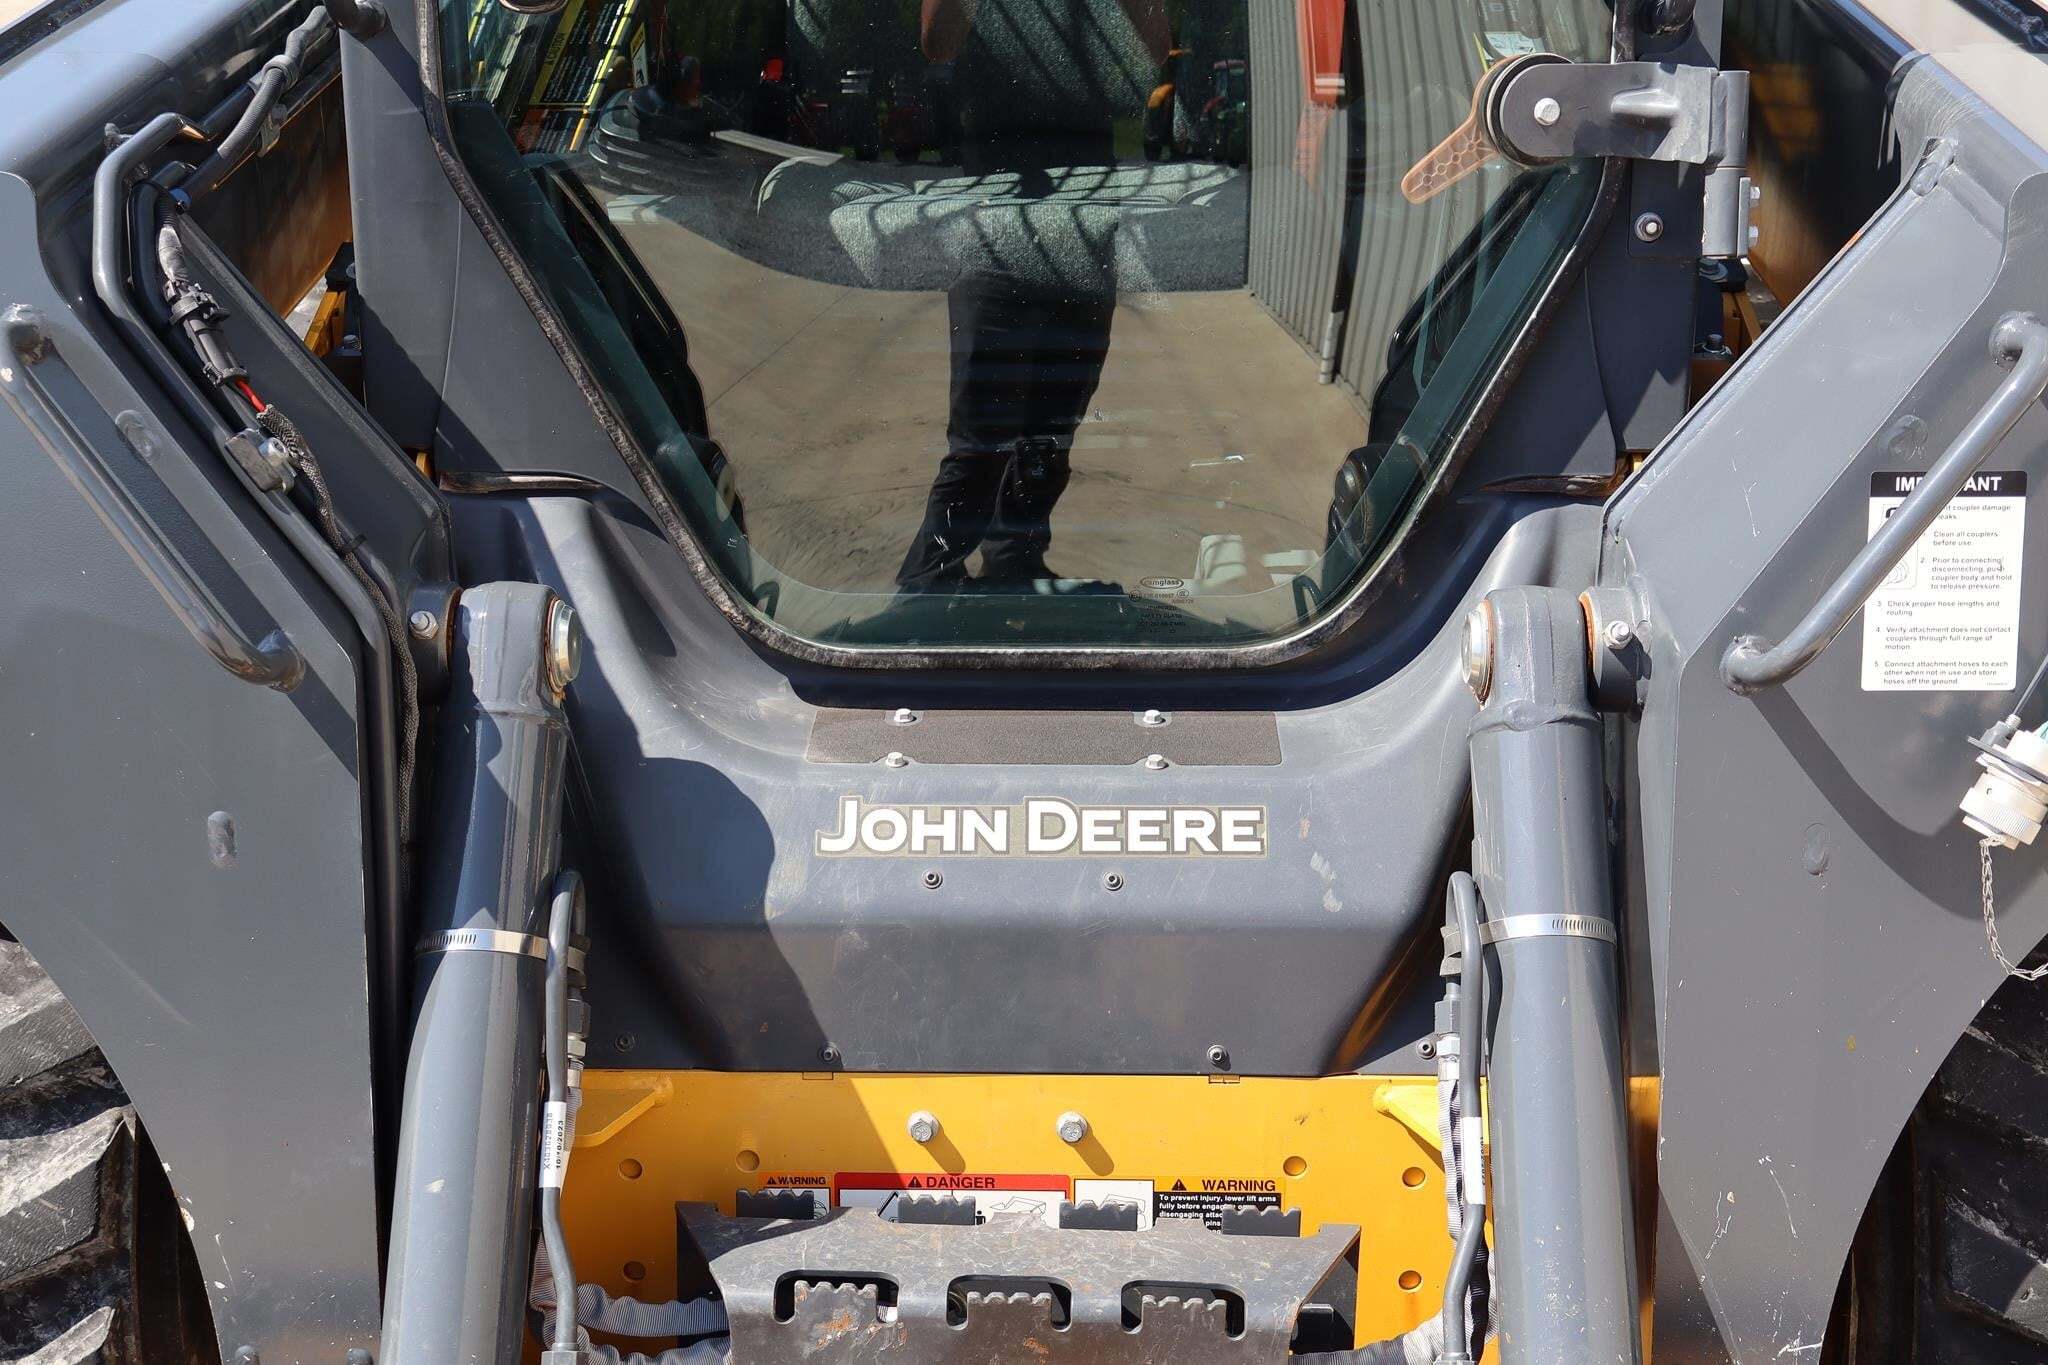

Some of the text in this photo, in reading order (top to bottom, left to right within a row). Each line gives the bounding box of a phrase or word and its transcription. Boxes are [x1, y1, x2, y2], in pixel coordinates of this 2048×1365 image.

[1896, 476, 2002, 492] IMANT
[1952, 504, 1980, 512] coupler
[1982, 504, 2011, 512] damage
[1933, 530, 1955, 538] Clean
[1956, 530, 1965, 538] all
[1966, 530, 1998, 538] couplers
[1887, 600, 1911, 608] Check
[1912, 600, 1936, 608] proper
[1937, 600, 1956, 608] hose
[1957, 600, 1984, 608] lengths
[1986, 600, 2000, 608] and
[820, 800, 1263, 853] JOHN DEERE
[778, 1177, 826, 1185] WARNING
[926, 1177, 995, 1188] DANGER
[1202, 1180, 1276, 1191] WARNING
[1160, 1194, 1276, 1202] To prevent injury, lower lift arms
